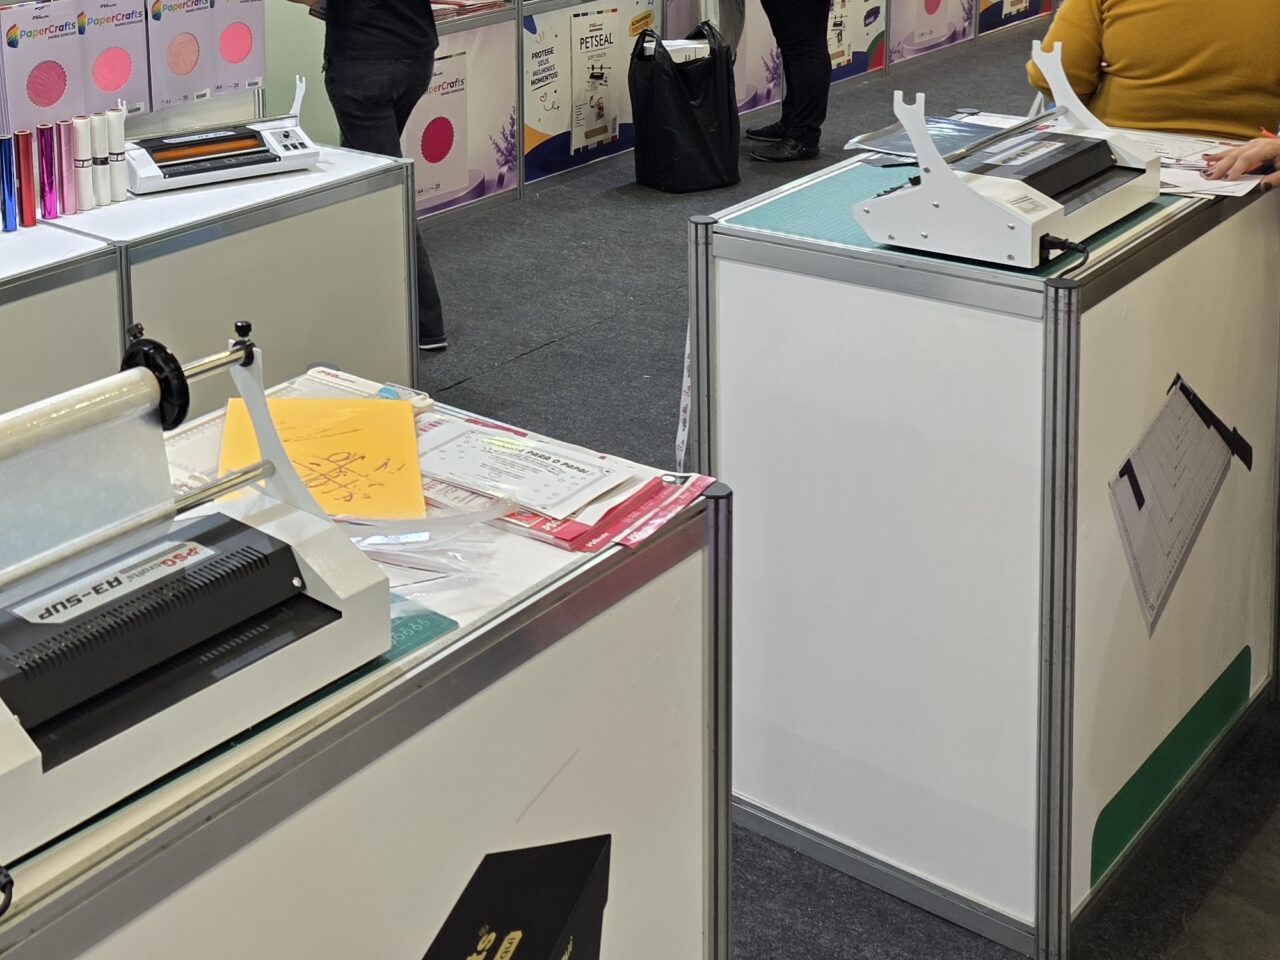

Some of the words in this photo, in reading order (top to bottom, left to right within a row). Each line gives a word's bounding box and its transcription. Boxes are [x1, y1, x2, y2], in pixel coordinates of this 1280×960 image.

[87, 10, 142, 27] PaperCrafts
[20, 22, 76, 39] PaperCrafts
[580, 33, 613, 50] PETSEAL
[38, 576, 122, 620] A3-SUP
